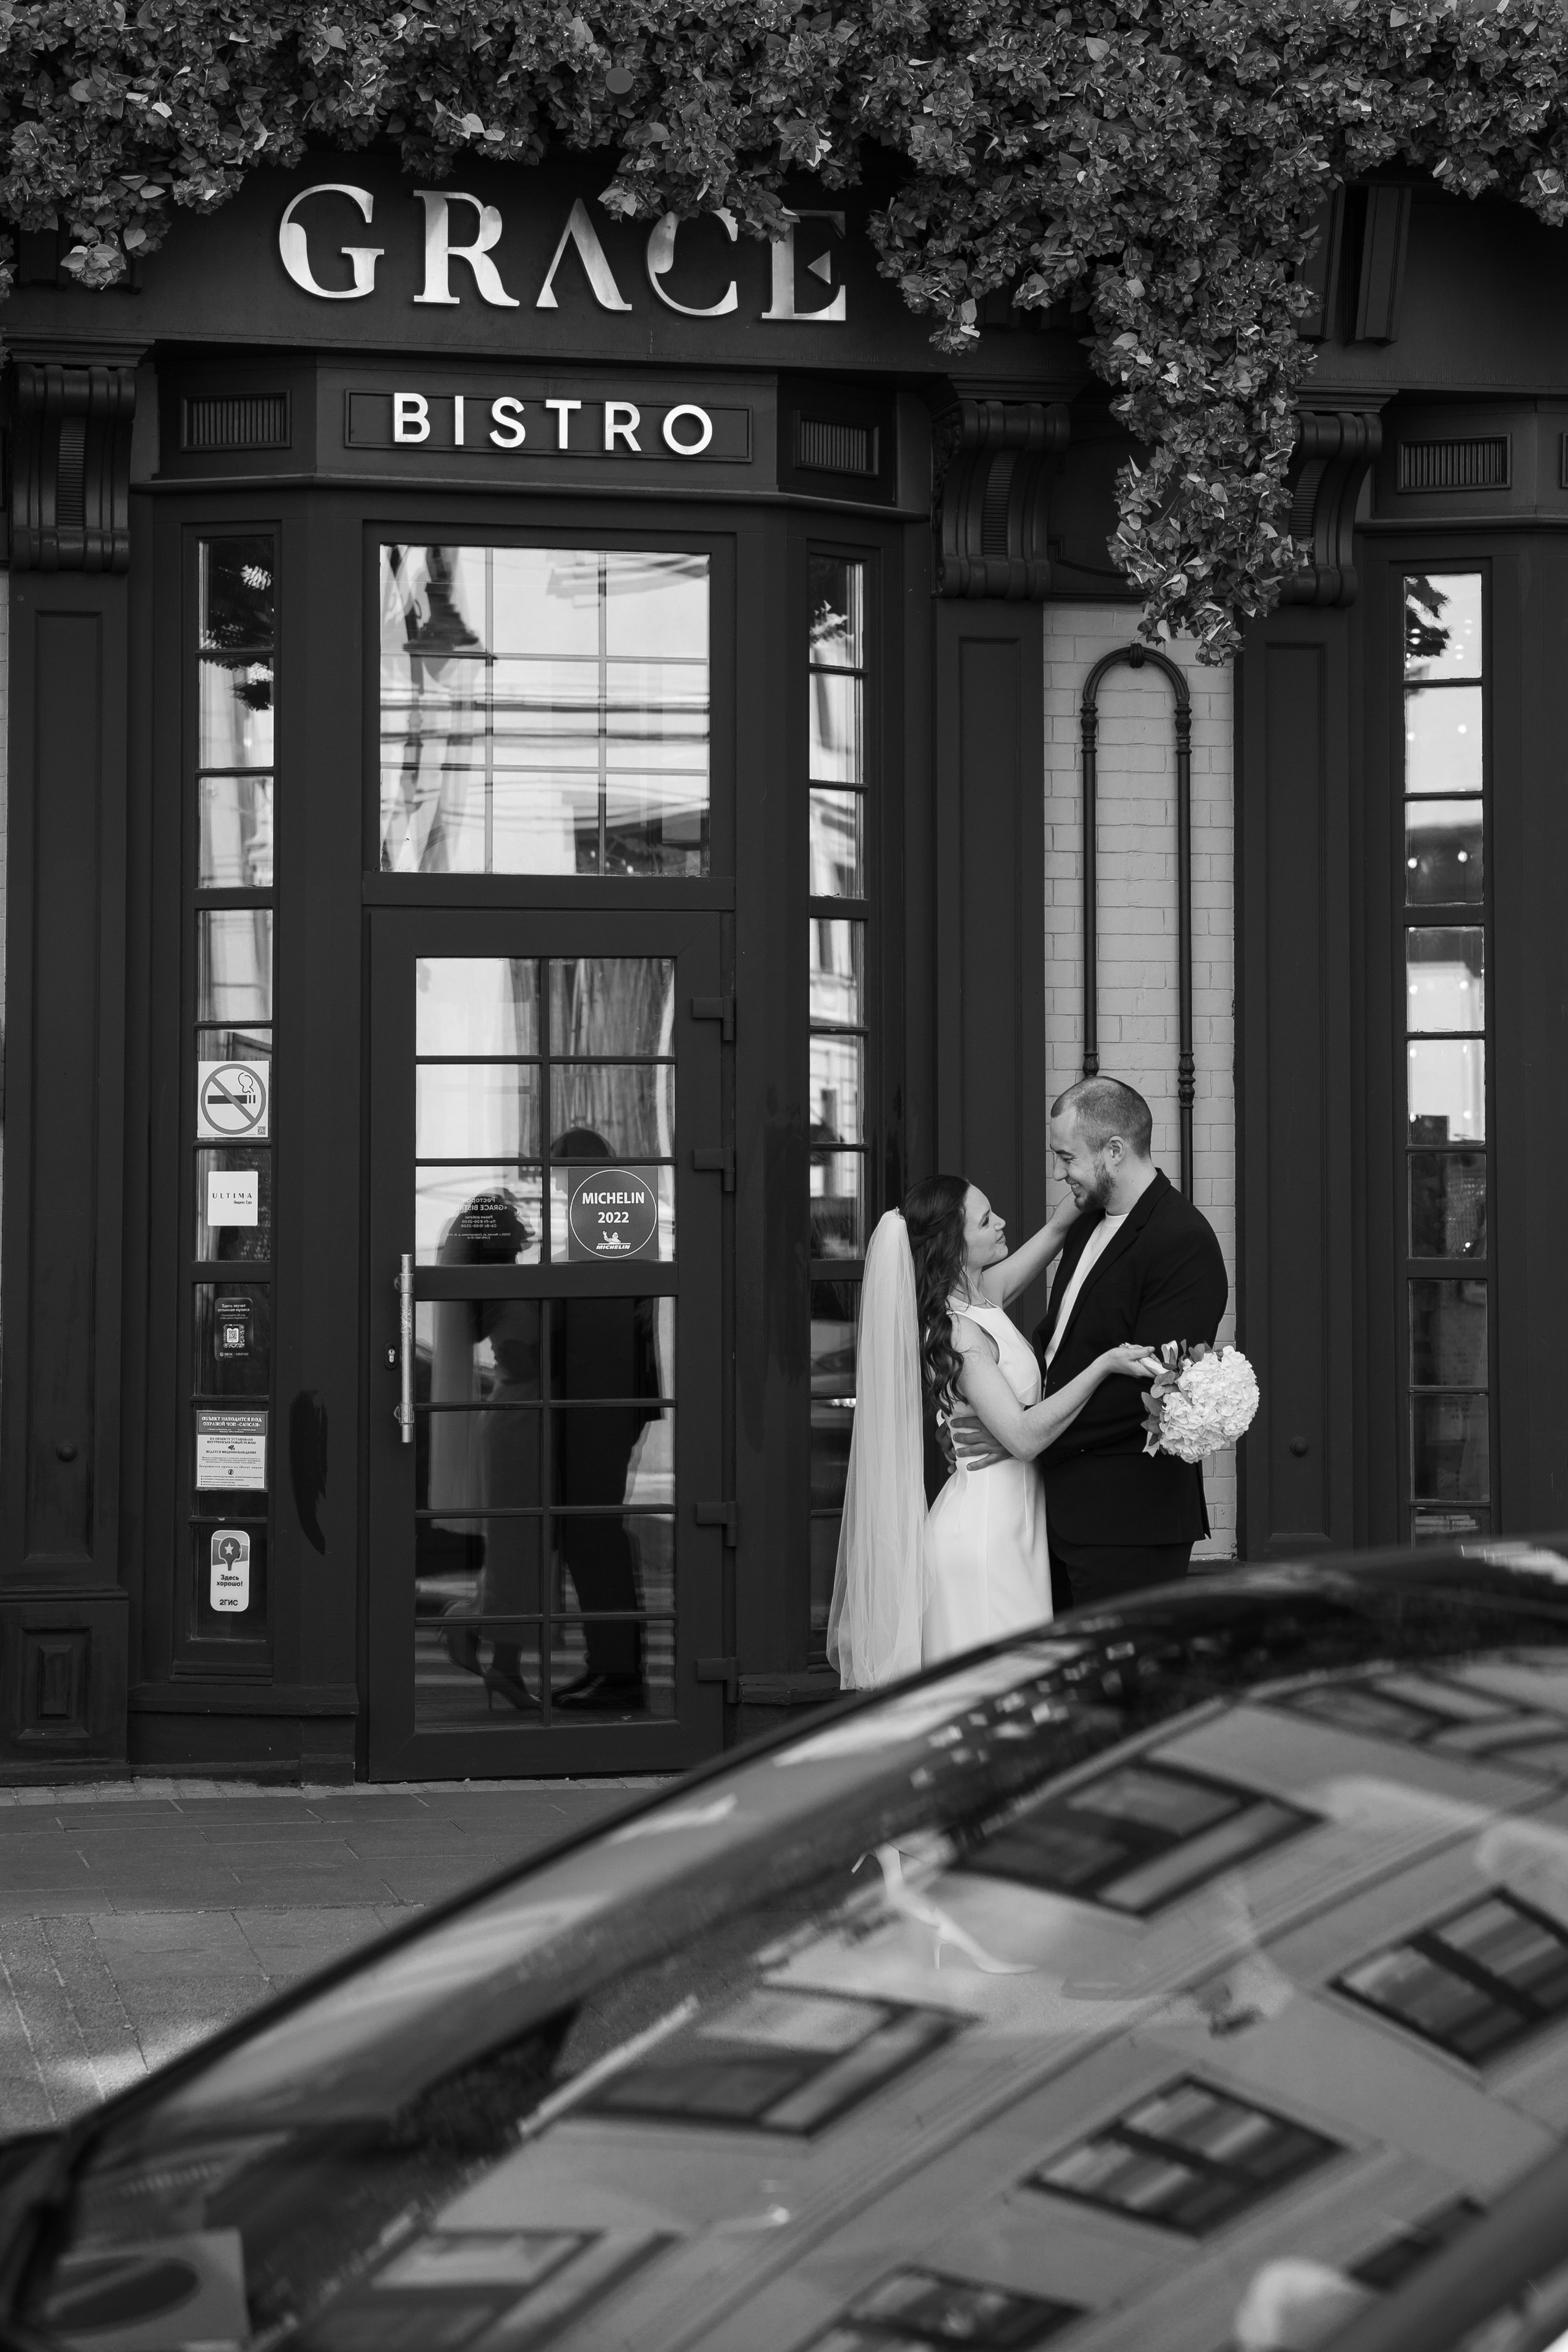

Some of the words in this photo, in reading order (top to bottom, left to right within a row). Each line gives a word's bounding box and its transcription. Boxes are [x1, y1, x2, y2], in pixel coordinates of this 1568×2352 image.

[279, 183, 846, 321] GRACE
[393, 393, 713, 456] BISTRO
[582, 1192, 644, 1204] MICHELIN
[598, 1212, 629, 1223] 2022
